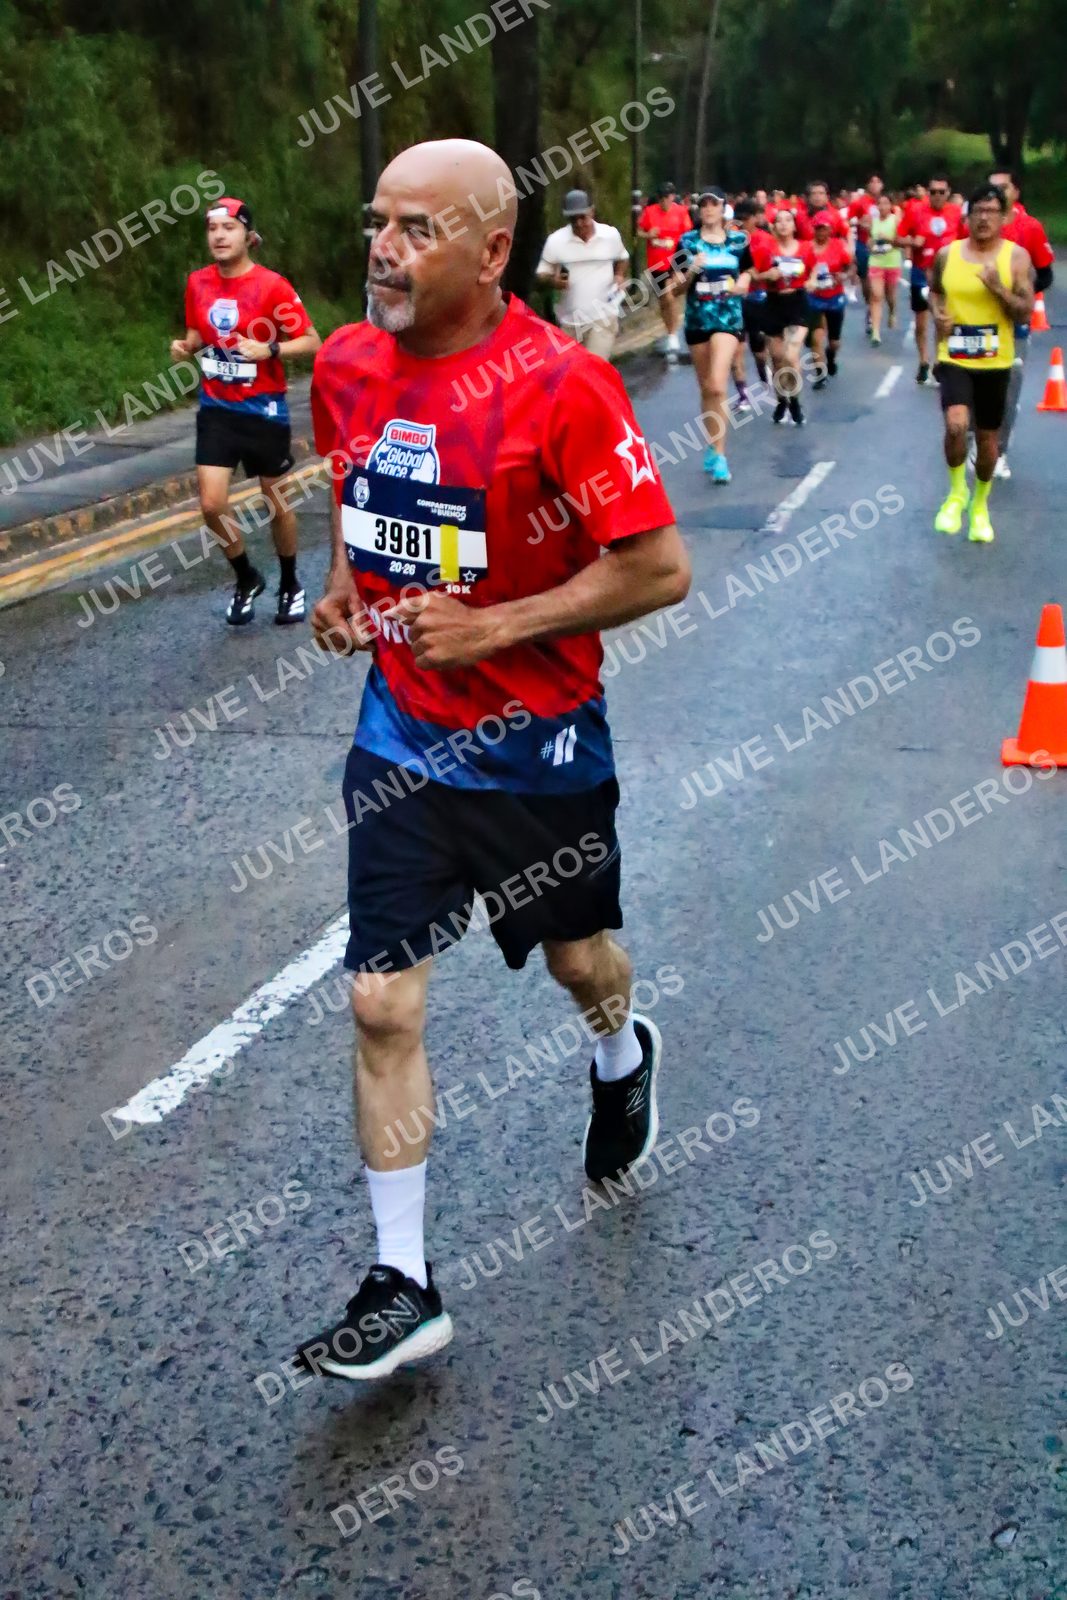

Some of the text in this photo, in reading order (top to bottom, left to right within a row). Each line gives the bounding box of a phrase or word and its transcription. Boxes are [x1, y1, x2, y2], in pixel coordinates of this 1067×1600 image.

[390, 428, 428, 446] BIMBO
[387, 447, 425, 469] Global
[376, 459, 409, 479] Race
[374, 518, 432, 560] 3981
[389, 560, 416, 576] 20-26
